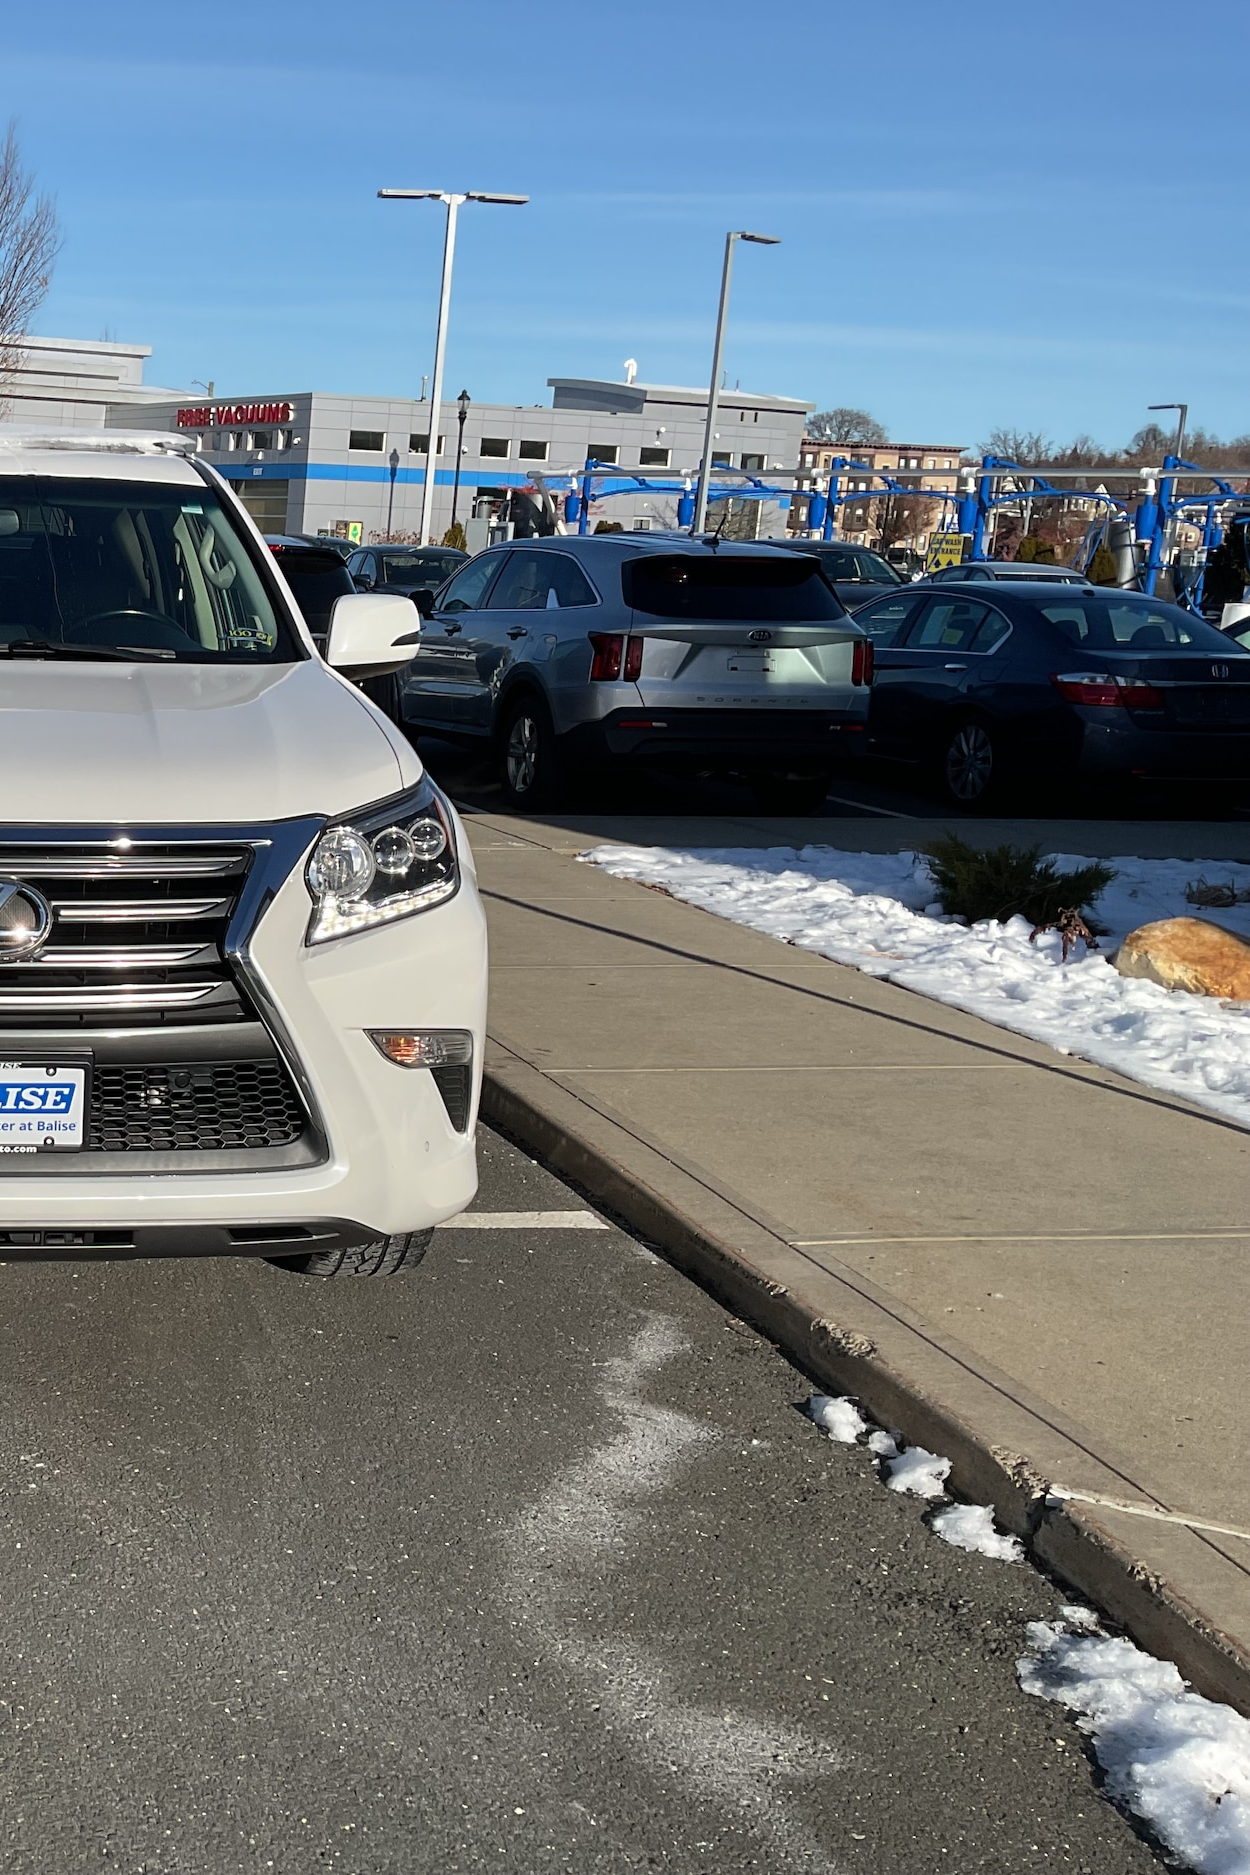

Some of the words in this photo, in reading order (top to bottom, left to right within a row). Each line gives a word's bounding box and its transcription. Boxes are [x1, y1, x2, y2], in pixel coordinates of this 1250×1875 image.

[216, 403, 294, 424] VACUUMS
[19, 1121, 32, 1131] at
[37, 1120, 77, 1131] Balise
